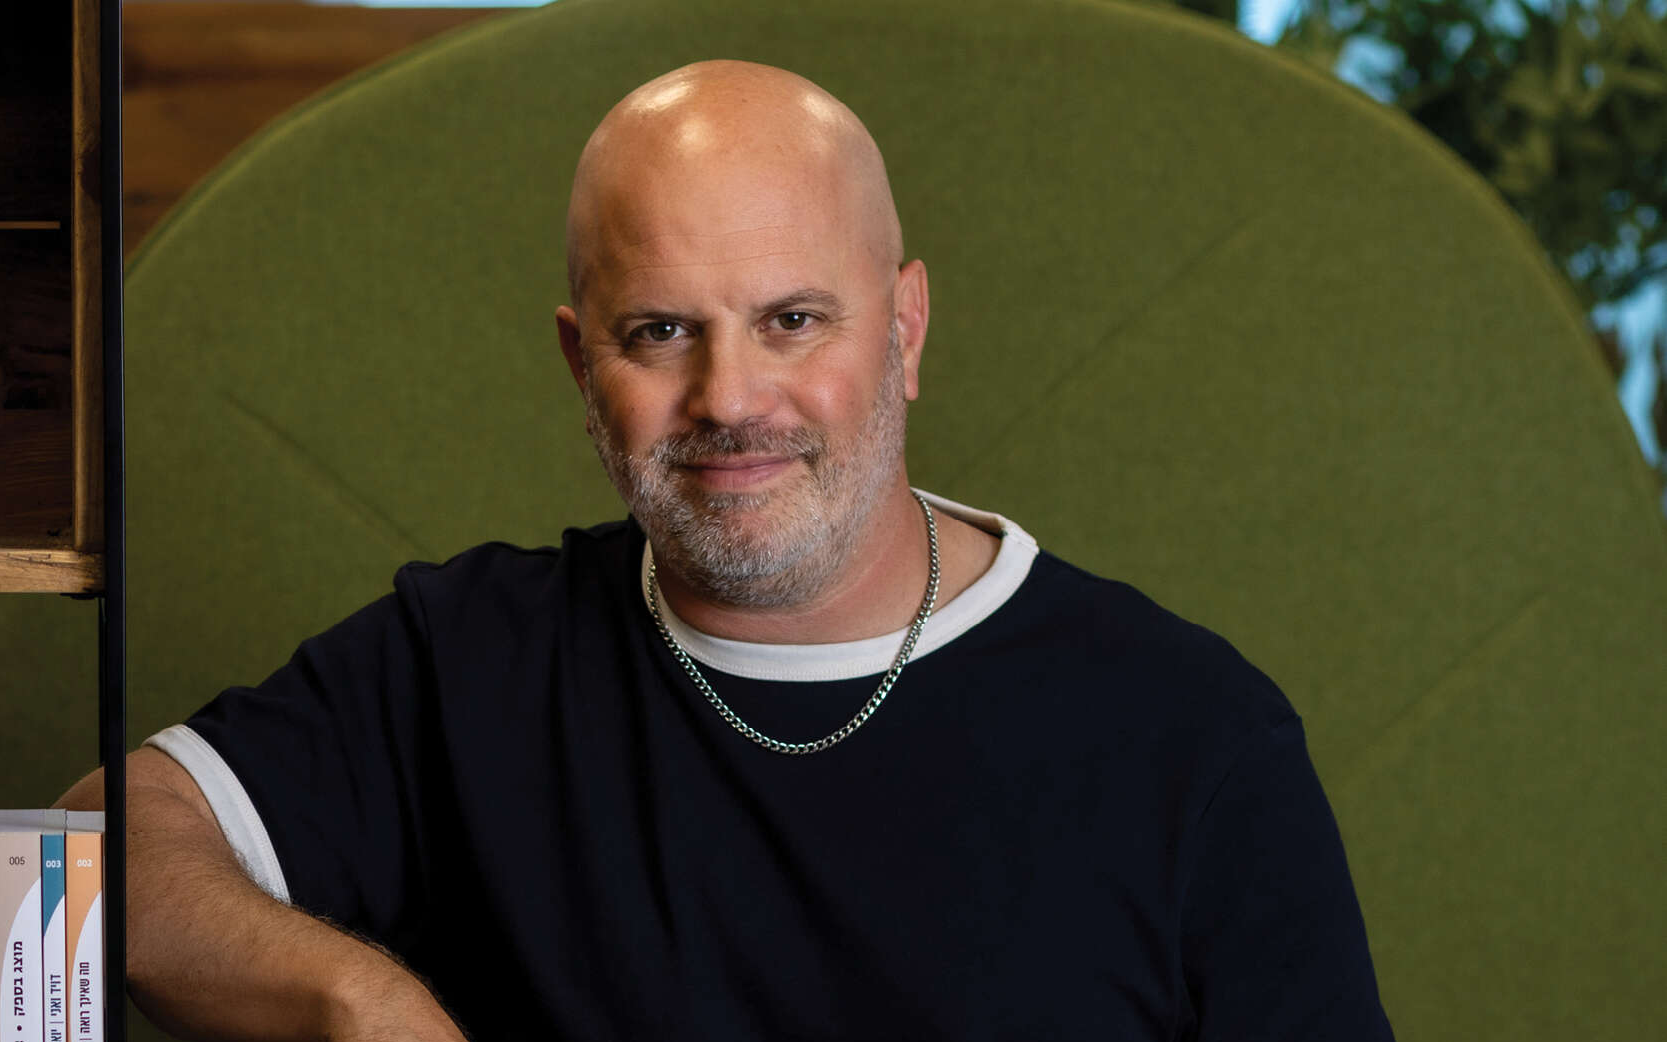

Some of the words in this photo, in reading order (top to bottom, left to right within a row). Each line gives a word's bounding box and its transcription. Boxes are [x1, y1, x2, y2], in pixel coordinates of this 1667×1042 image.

[9, 856, 26, 866] 005
[45, 860, 61, 868] 003
[76, 858, 93, 867] 002
[12, 941, 24, 973] מוצג
[79, 962, 90, 975] מה
[50, 974, 62, 995] דויד
[80, 978, 92, 1006] שאינך
[12, 976, 26, 1016] בספק
[51, 996, 63, 1017] ואני
[80, 1011, 91, 1034] רואה
